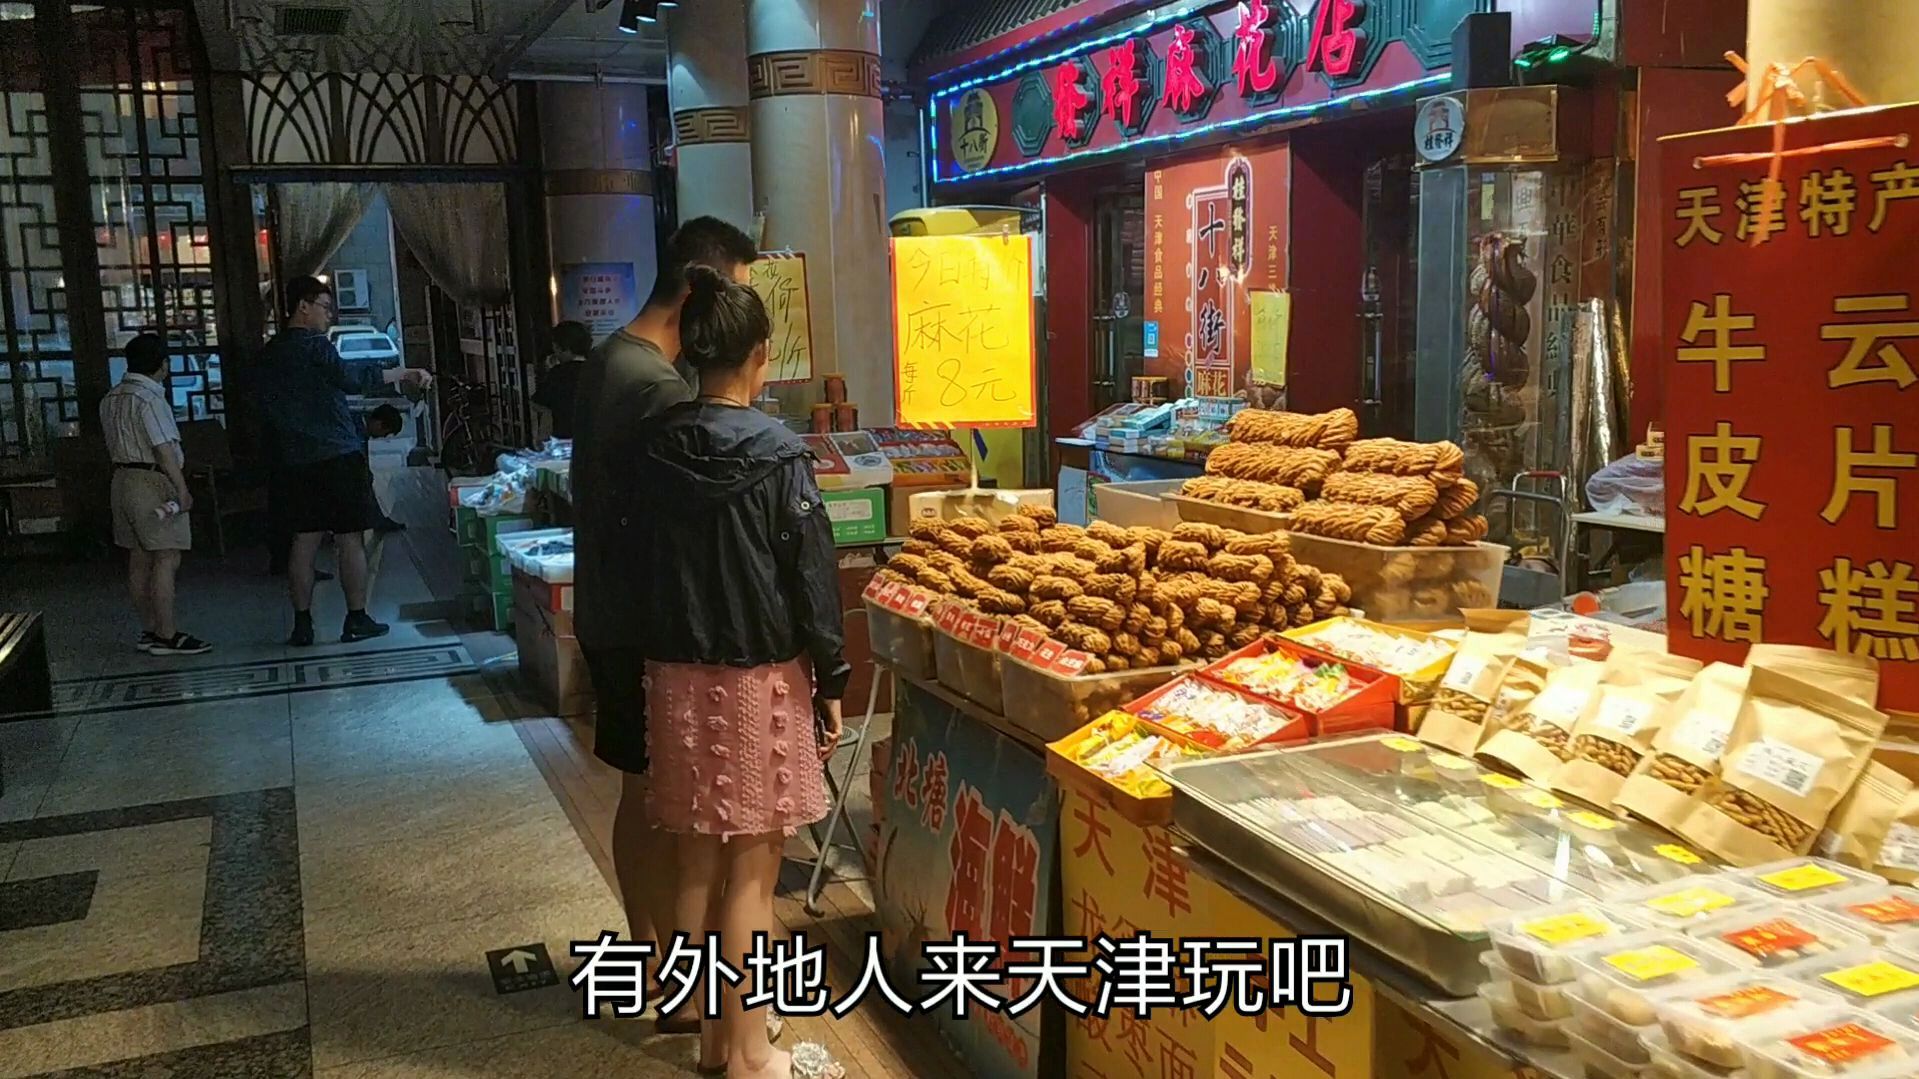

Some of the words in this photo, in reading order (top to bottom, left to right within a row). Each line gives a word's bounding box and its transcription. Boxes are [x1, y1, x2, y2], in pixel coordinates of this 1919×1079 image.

[1675, 162, 1919, 248] 天津特产
[904, 301, 1009, 355] 麻花
[1198, 201, 1227, 354] 十八街
[936, 358, 1017, 407] 8元
[1676, 293, 1769, 645] 牛皮糖
[1818, 293, 1919, 662] 云片糕
[1073, 789, 1192, 919] 天津
